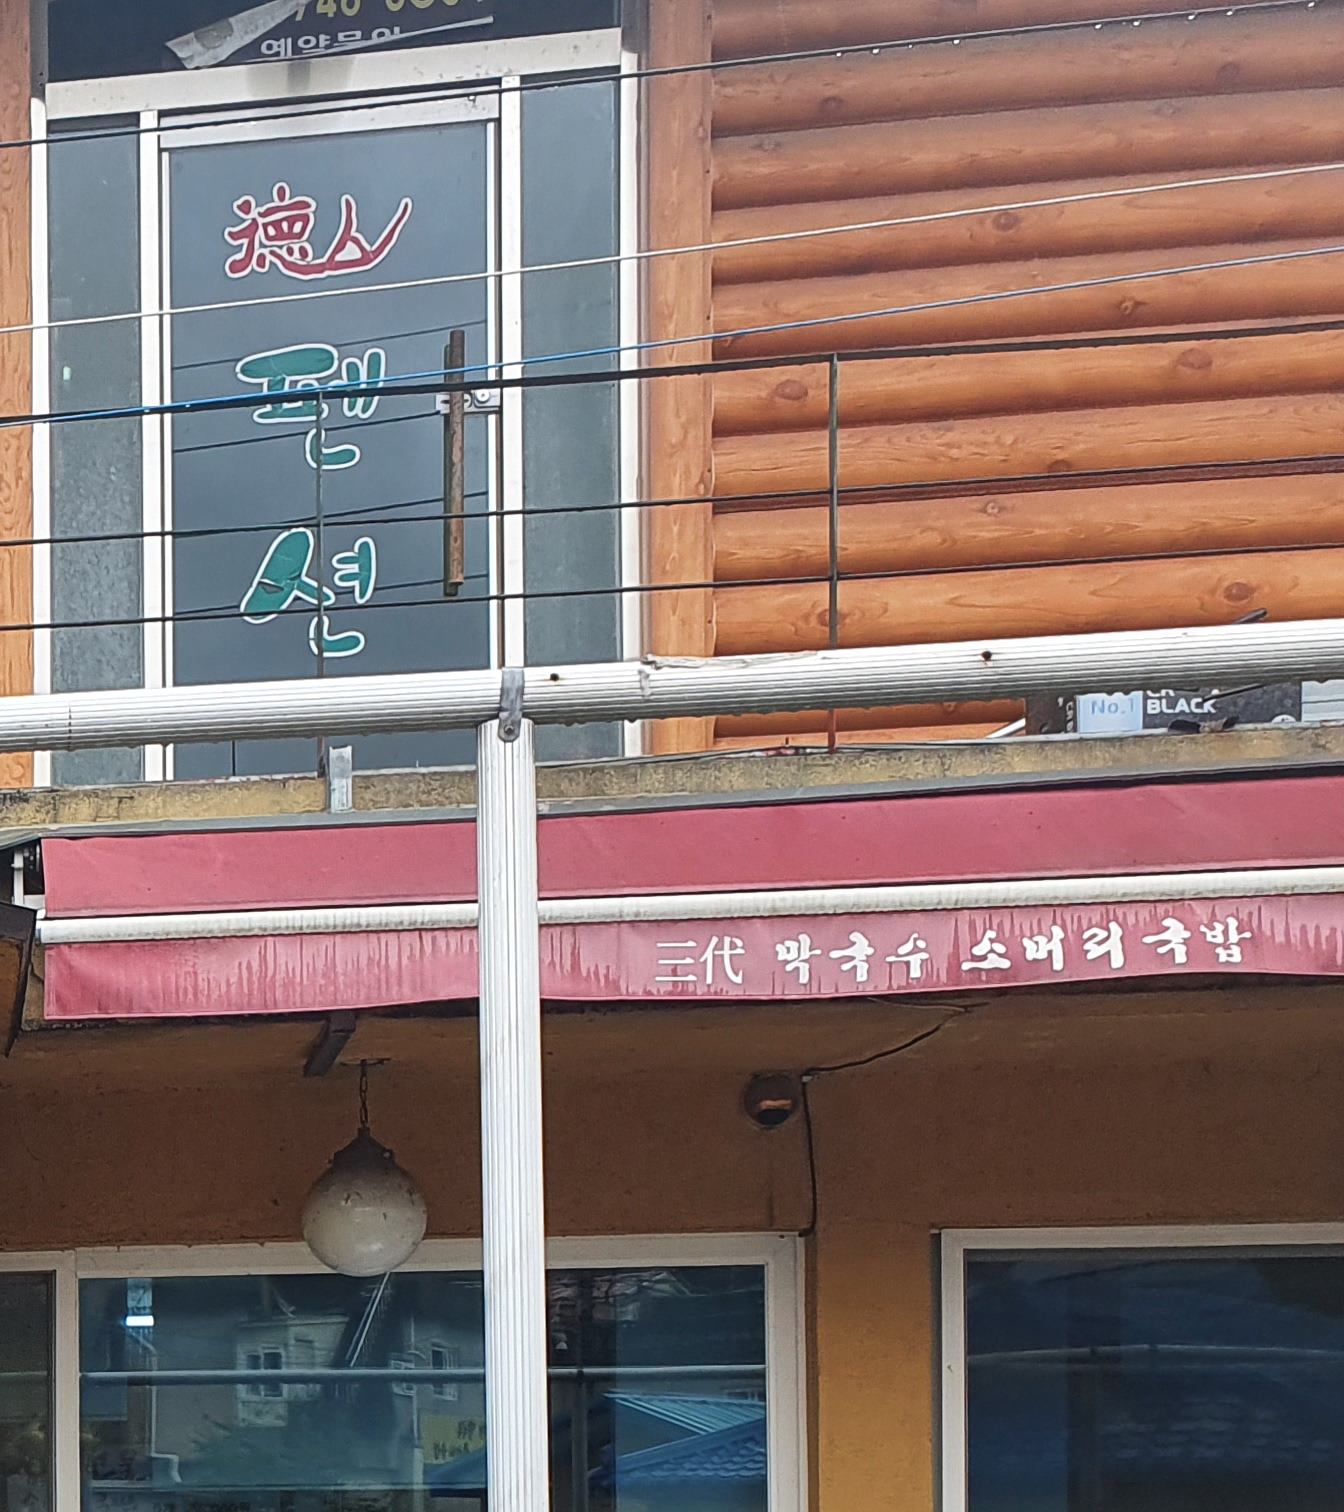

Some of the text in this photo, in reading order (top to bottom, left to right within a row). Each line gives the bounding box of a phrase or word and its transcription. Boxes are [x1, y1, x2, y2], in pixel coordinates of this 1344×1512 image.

[1147, 698, 1216, 714] BLACK
[655, 936, 746, 986] 三代
[775, 933, 930, 984] 막국수
